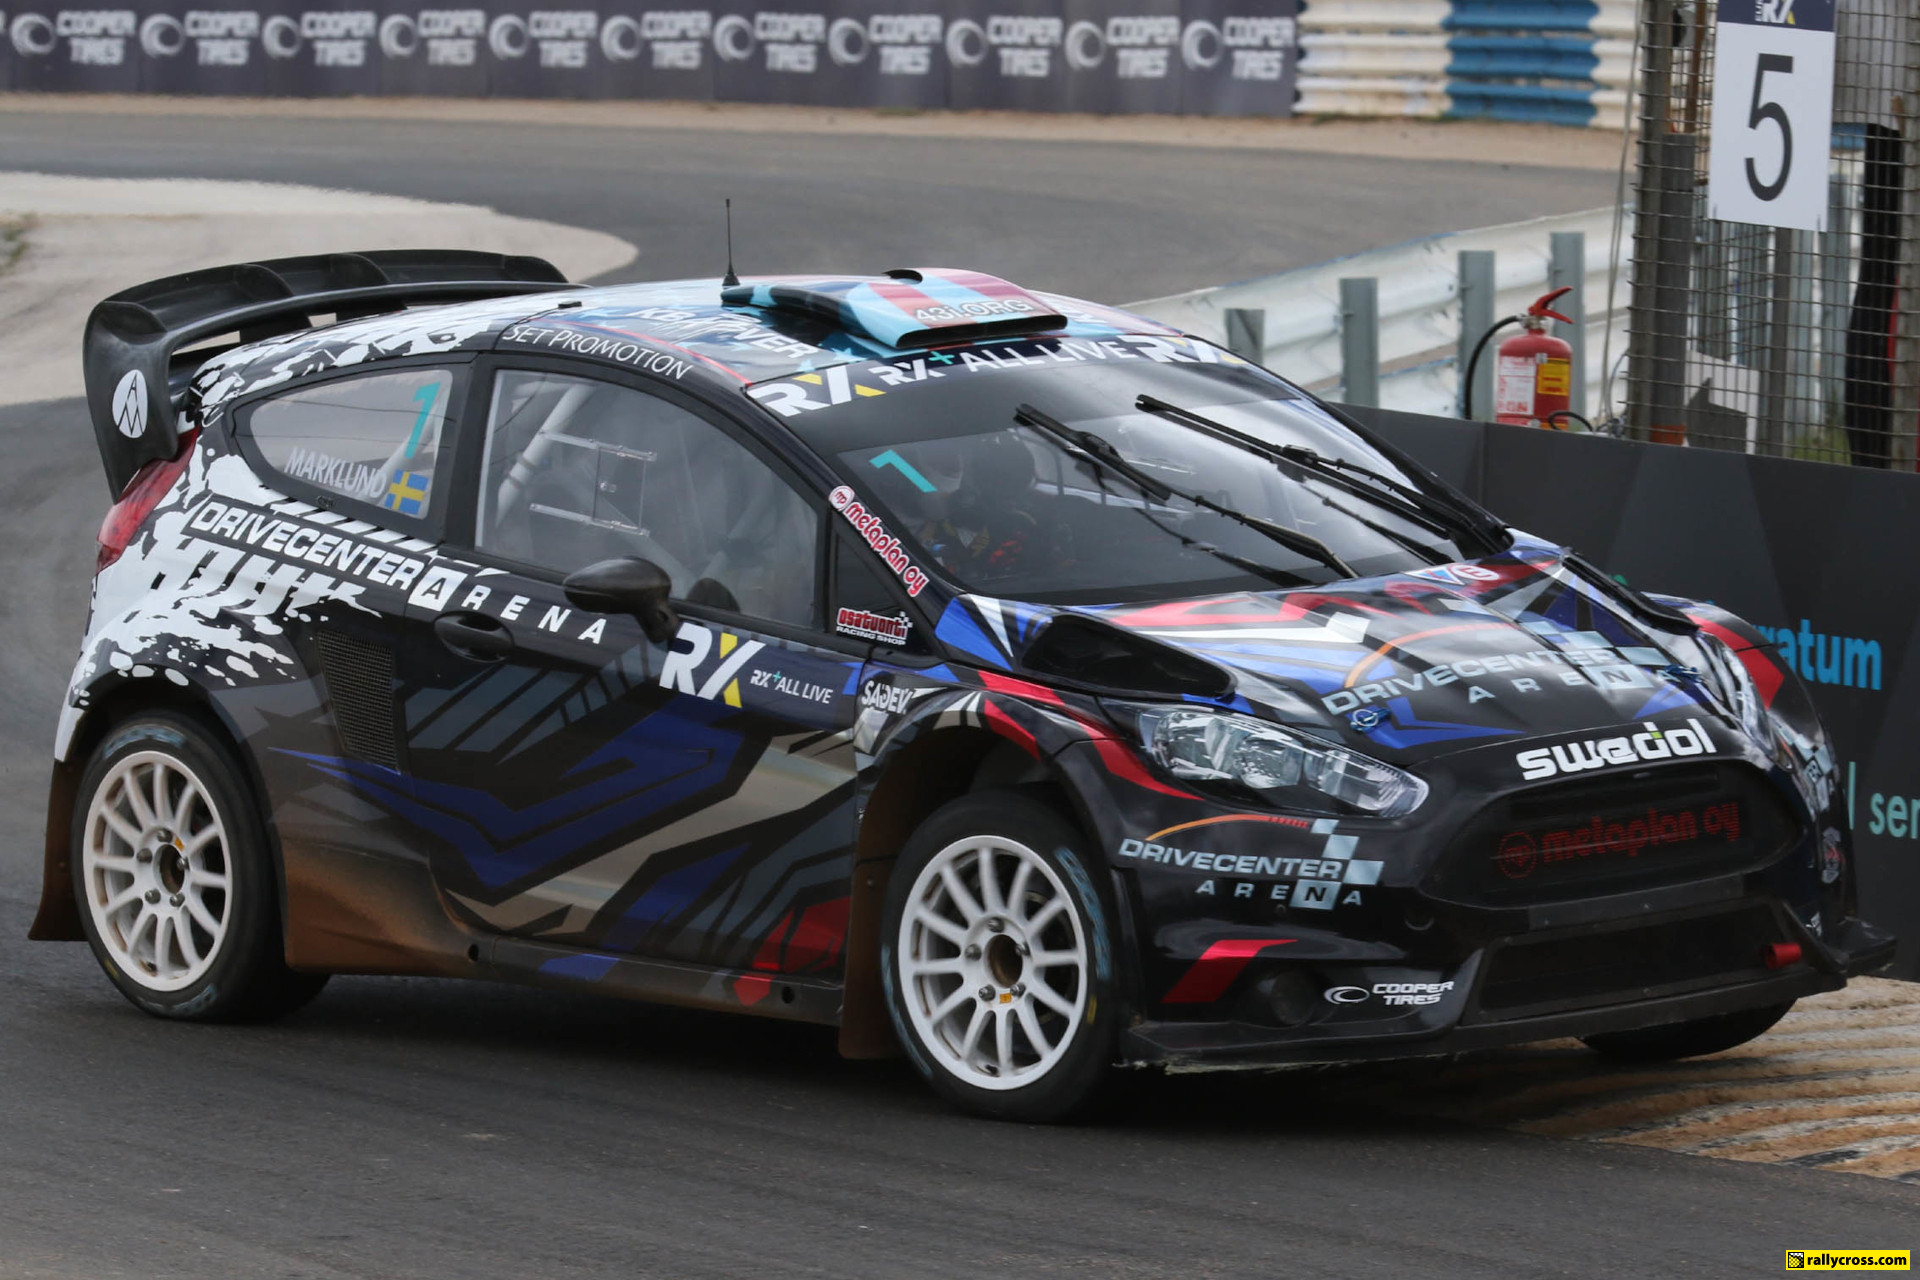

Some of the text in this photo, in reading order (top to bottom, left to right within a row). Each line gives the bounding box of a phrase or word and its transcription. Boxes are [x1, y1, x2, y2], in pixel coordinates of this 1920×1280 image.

[57, 11, 135, 35] COOPER
[185, 11, 259, 37] COOPER
[301, 12, 376, 38] COOPER
[417, 10, 485, 37] COOPER
[527, 11, 597, 38] COOPER
[639, 11, 711, 39] COOPER
[754, 13, 825, 41] COOPER
[866, 14, 942, 43] COOPER
[985, 16, 1062, 46] COOPER
[1103, 16, 1181, 46] COOPER
[1221, 17, 1295, 47] COOPER
[71, 37, 123, 64] TIRES
[199, 39, 248, 65] TIRES
[315, 40, 364, 66] TIRES
[428, 39, 475, 65] TIRES
[540, 40, 587, 67] TIRES
[652, 41, 701, 68] TIRES
[767, 43, 816, 72] TIRES
[880, 46, 930, 74] TIRES
[1000, 48, 1050, 77] TIRES
[1117, 48, 1169, 78] TIRES
[1233, 50, 1283, 80] TIRES
[1745, 52, 1794, 202] 5
[502, 324, 694, 380] SET PROMOTION
[959, 346, 1040, 373] ALL
[1043, 337, 1138, 363] LIVE
[747, 364, 886, 418] RX
[405, 381, 441, 458] 1
[284, 446, 388, 499] MARKLUND
[868, 449, 938, 493] 1
[844, 501, 907, 575] metaplan
[904, 564, 930, 597] oy
[190, 500, 608, 645] DRIVECENTER ARENA
[836, 625, 906, 645] RACING SHOP
[659, 621, 767, 709] RX
[776, 676, 801, 697] ALL
[802, 684, 834, 704] LIVE
[1321, 648, 1621, 716] DRIVECENTER
[861, 680, 913, 714] SADEV
[1516, 718, 1717, 781] swedol
[1542, 808, 1698, 857] metaplan
[1703, 803, 1741, 842] oy
[1118, 838, 1343, 880] DRIVECENTER
[1196, 880, 1363, 907] ARENA
[1372, 981, 1454, 996] COOPER
[1383, 992, 1442, 1006] TIRES
